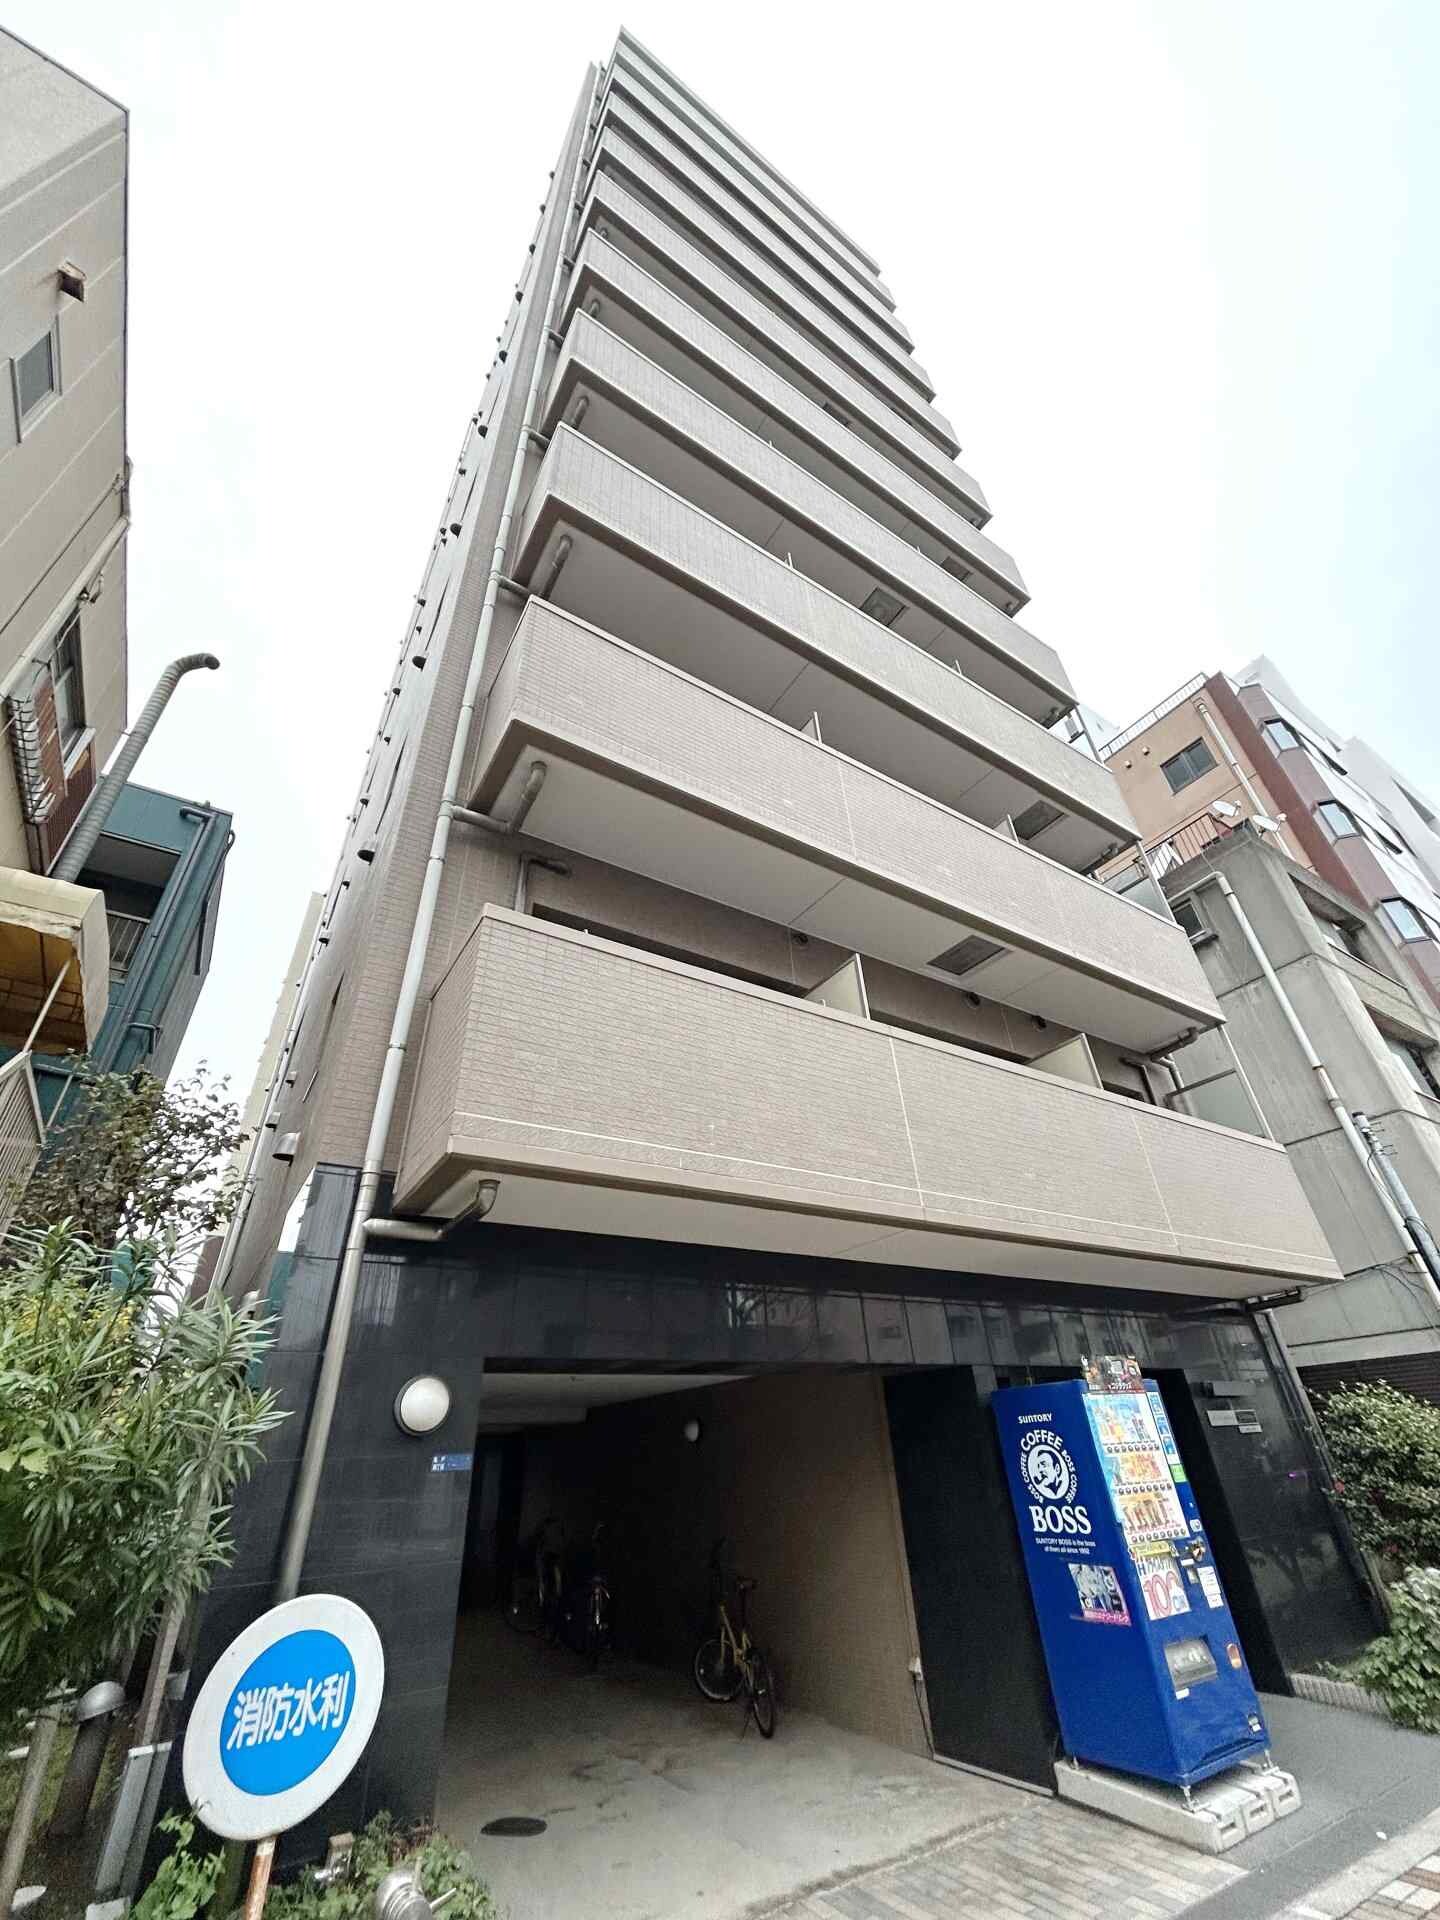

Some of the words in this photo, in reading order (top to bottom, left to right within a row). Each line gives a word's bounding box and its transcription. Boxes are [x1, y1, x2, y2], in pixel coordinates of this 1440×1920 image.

[1018, 1413, 1052, 1424] SUNTORY
[1020, 1429, 1064, 1452] COFFEE
[1020, 1452, 1030, 1483] COFFEE
[1061, 1449, 1076, 1473] BOSS
[1027, 1484, 1044, 1504] BOSS
[1066, 1474, 1078, 1504] COFFEE
[1028, 1505, 1092, 1535] BOSS
[227, 1670, 350, 1750] 消防水利
